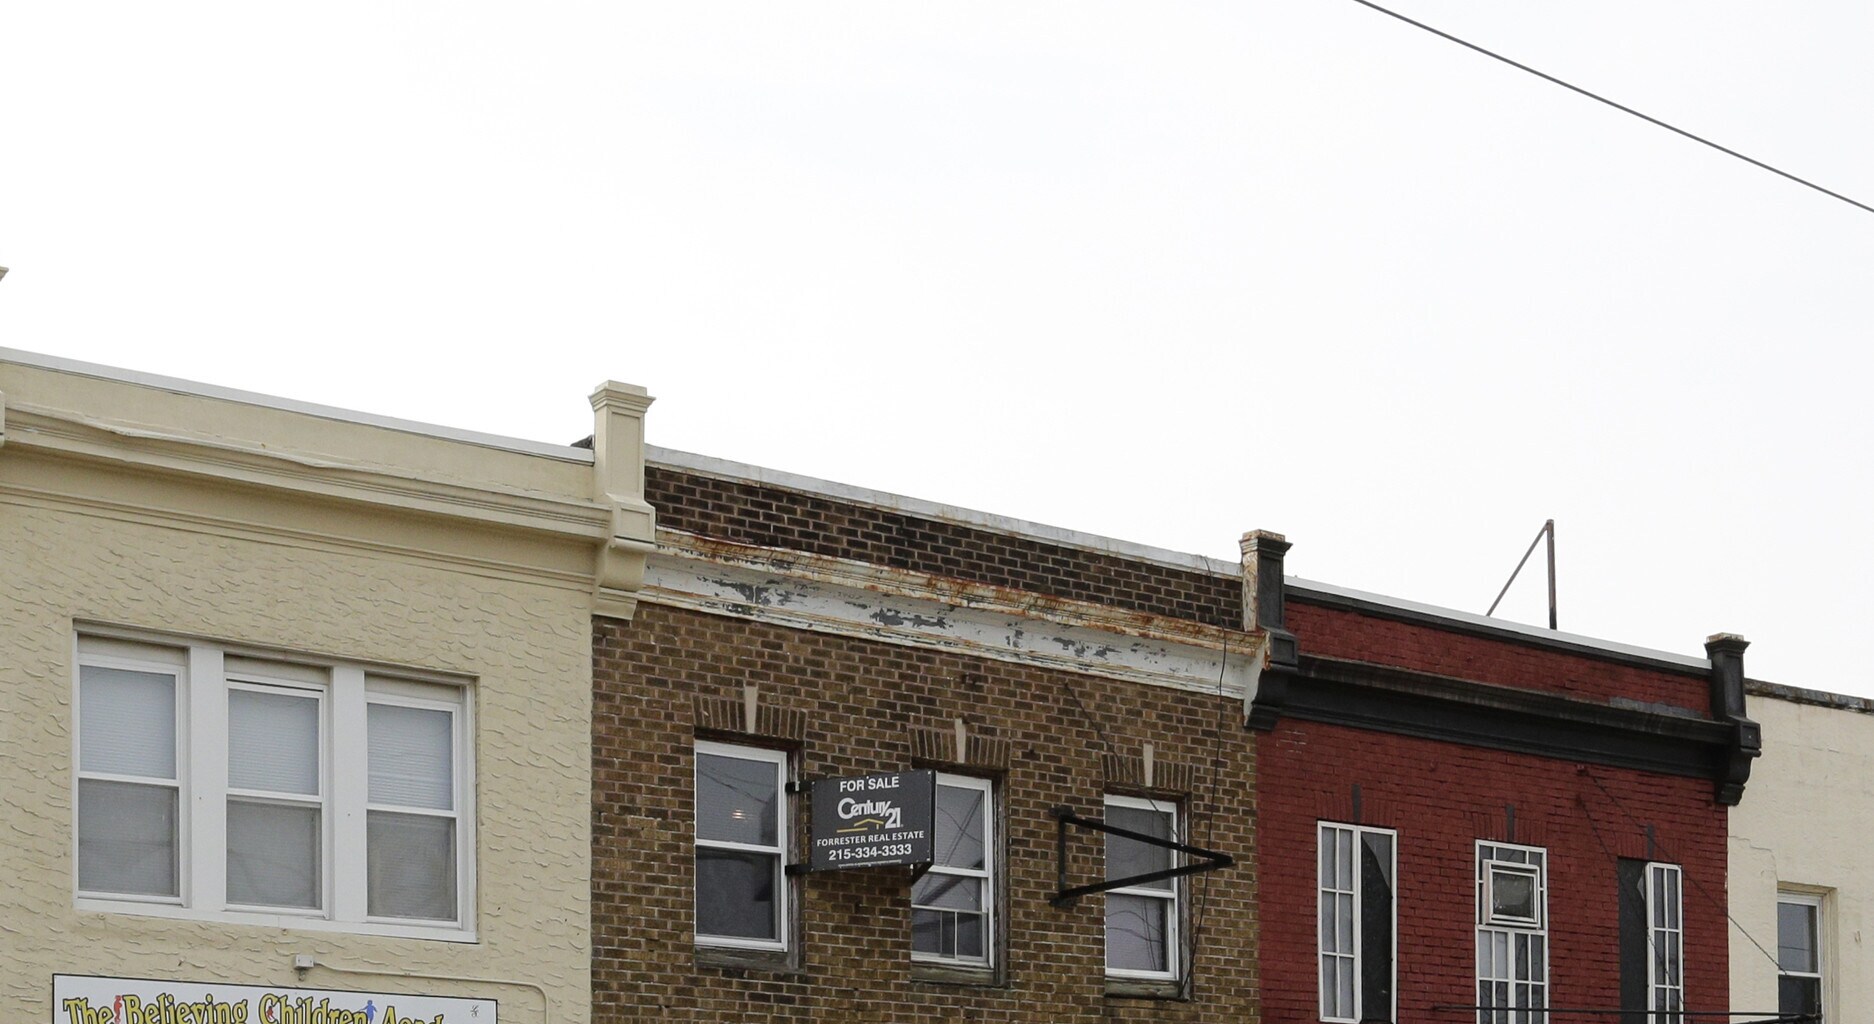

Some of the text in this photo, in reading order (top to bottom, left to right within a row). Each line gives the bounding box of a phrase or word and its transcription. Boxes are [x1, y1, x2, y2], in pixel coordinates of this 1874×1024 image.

[840, 776, 900, 793] FOR SALE
[837, 797, 902, 829] Century 21
[816, 830, 925, 847] FORRESTER REAL ESTATE
[828, 843, 912, 861] 215-334-3333
